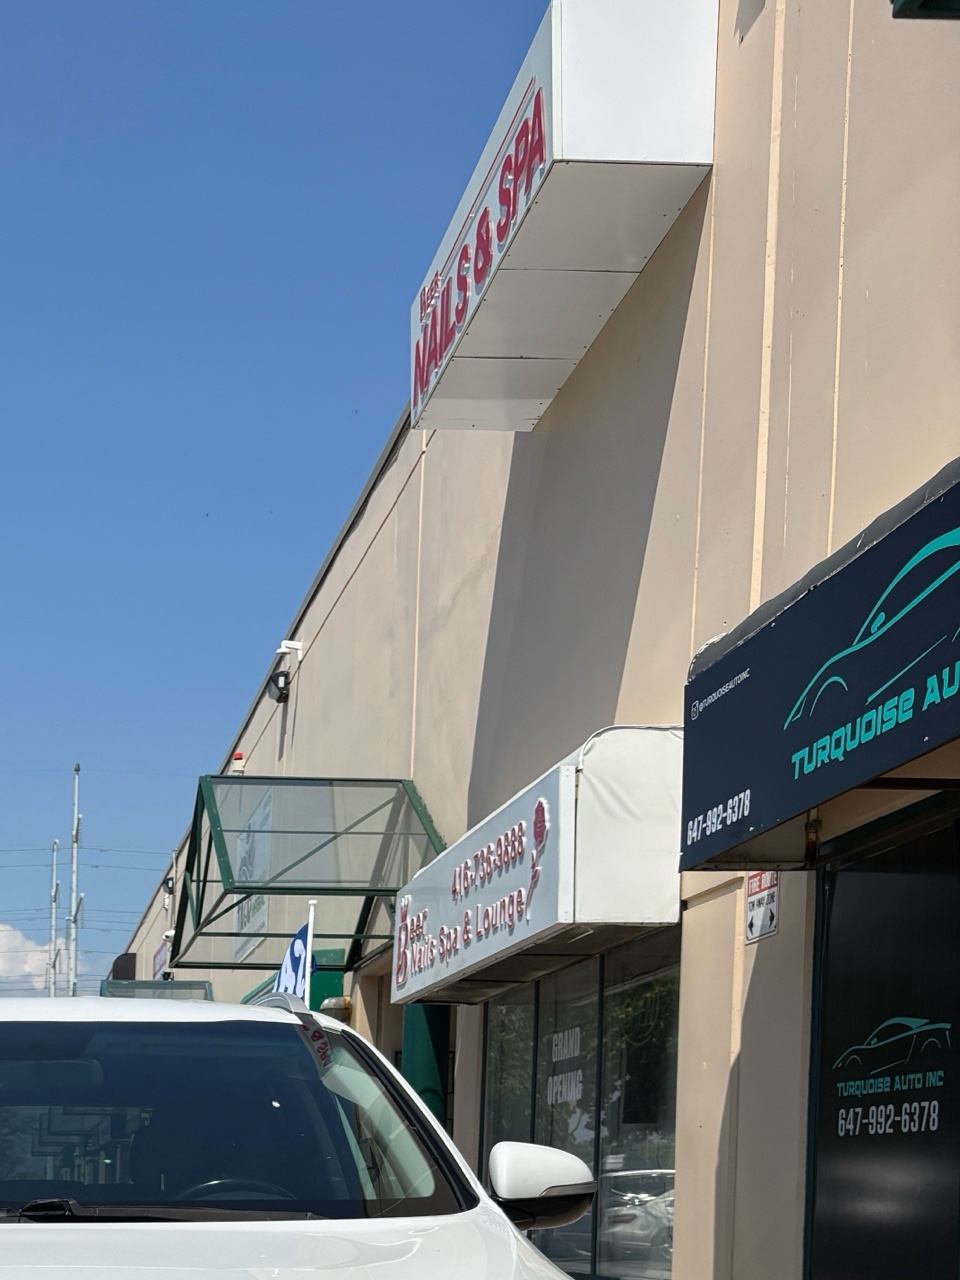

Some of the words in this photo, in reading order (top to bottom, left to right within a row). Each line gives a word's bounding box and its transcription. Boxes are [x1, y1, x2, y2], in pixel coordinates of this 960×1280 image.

[412, 243, 471, 411] NAILS
[473, 206, 492, 285] &
[496, 86, 546, 243] SPA
[791, 687, 915, 780] TURQUOISE
[687, 789, 750, 845] 647-992-6378
[396, 908, 428, 986] Beer
[411, 934, 436, 972] Nails
[439, 925, 460, 964] Spa
[463, 910, 472, 943] &
[476, 888, 526, 937] Lounge
[552, 1027, 580, 1062] GRAND
[547, 1069, 582, 1105] OPENING
[837, 1077, 890, 1097] TURQUOISE
[894, 1073, 922, 1091] AUTO
[926, 1069, 944, 1087] INC
[838, 1101, 938, 1136] 647-992-6378
